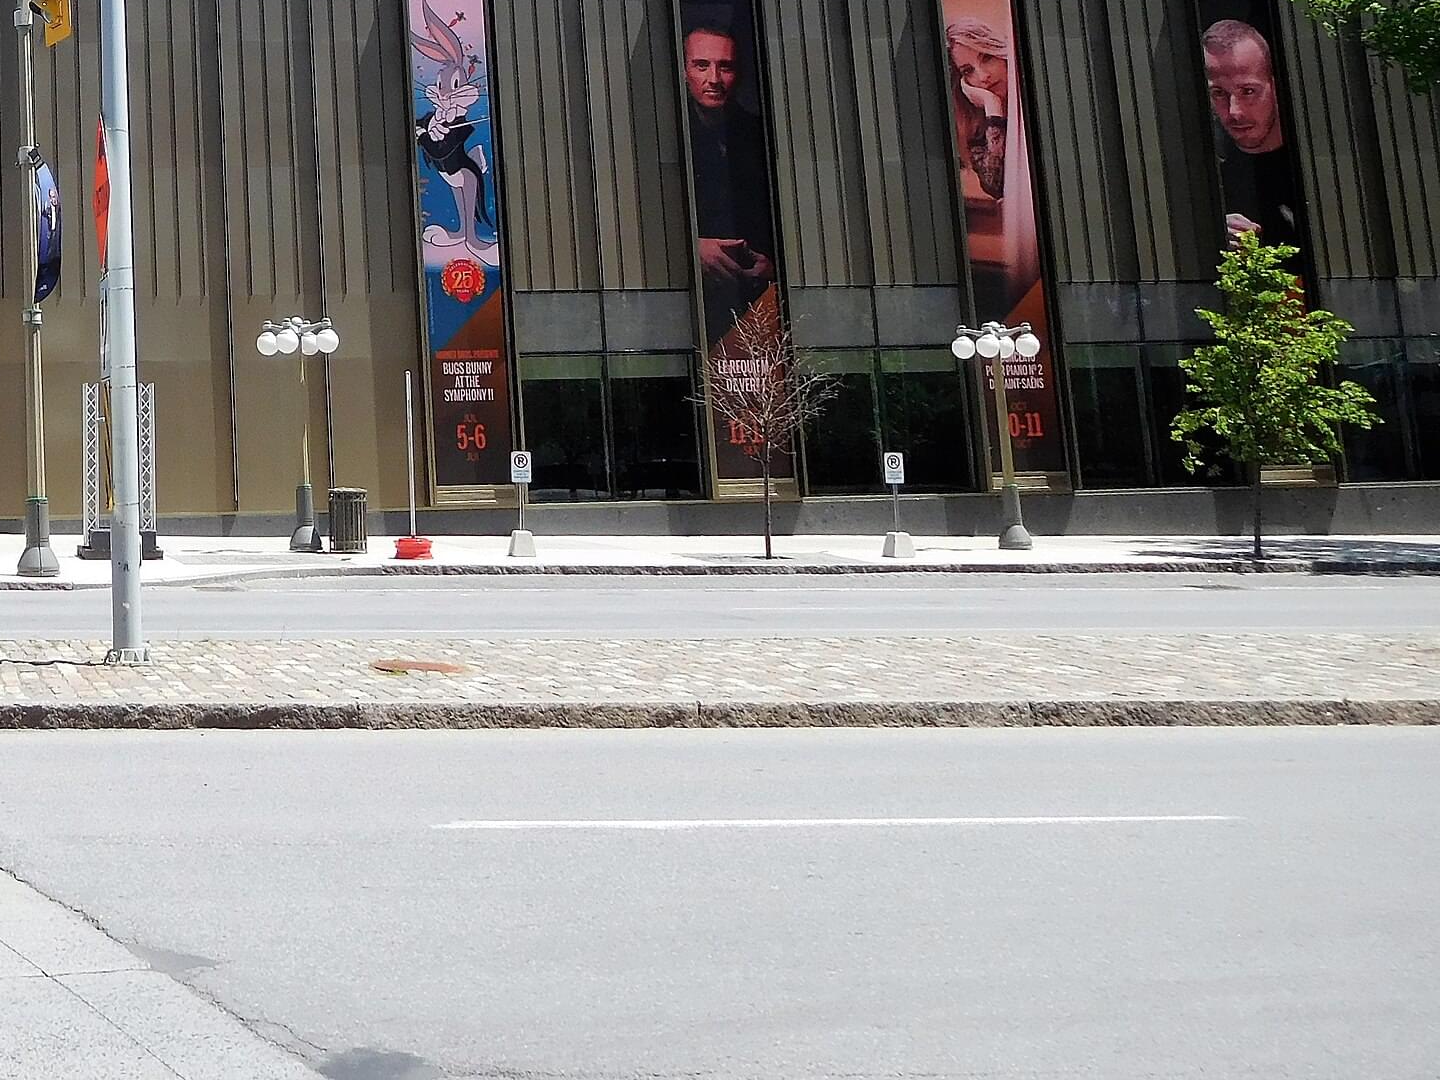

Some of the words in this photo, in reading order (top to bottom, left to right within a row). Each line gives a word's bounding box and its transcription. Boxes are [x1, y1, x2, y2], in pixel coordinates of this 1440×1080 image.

[451, 270, 474, 289] 25
[442, 361, 465, 375] BUGS
[465, 361, 492, 375] BUNNY
[718, 360, 728, 373] LE
[1005, 364, 1028, 376] PIANO
[1037, 363, 1044, 375] 2
[455, 375, 464, 388] AT
[464, 375, 481, 388] THE
[1004, 375, 1044, 389] AINT-SAËNS
[444, 388, 486, 401] SYMPHONY
[487, 388, 494, 400] II
[456, 424, 486, 450] 5-6
